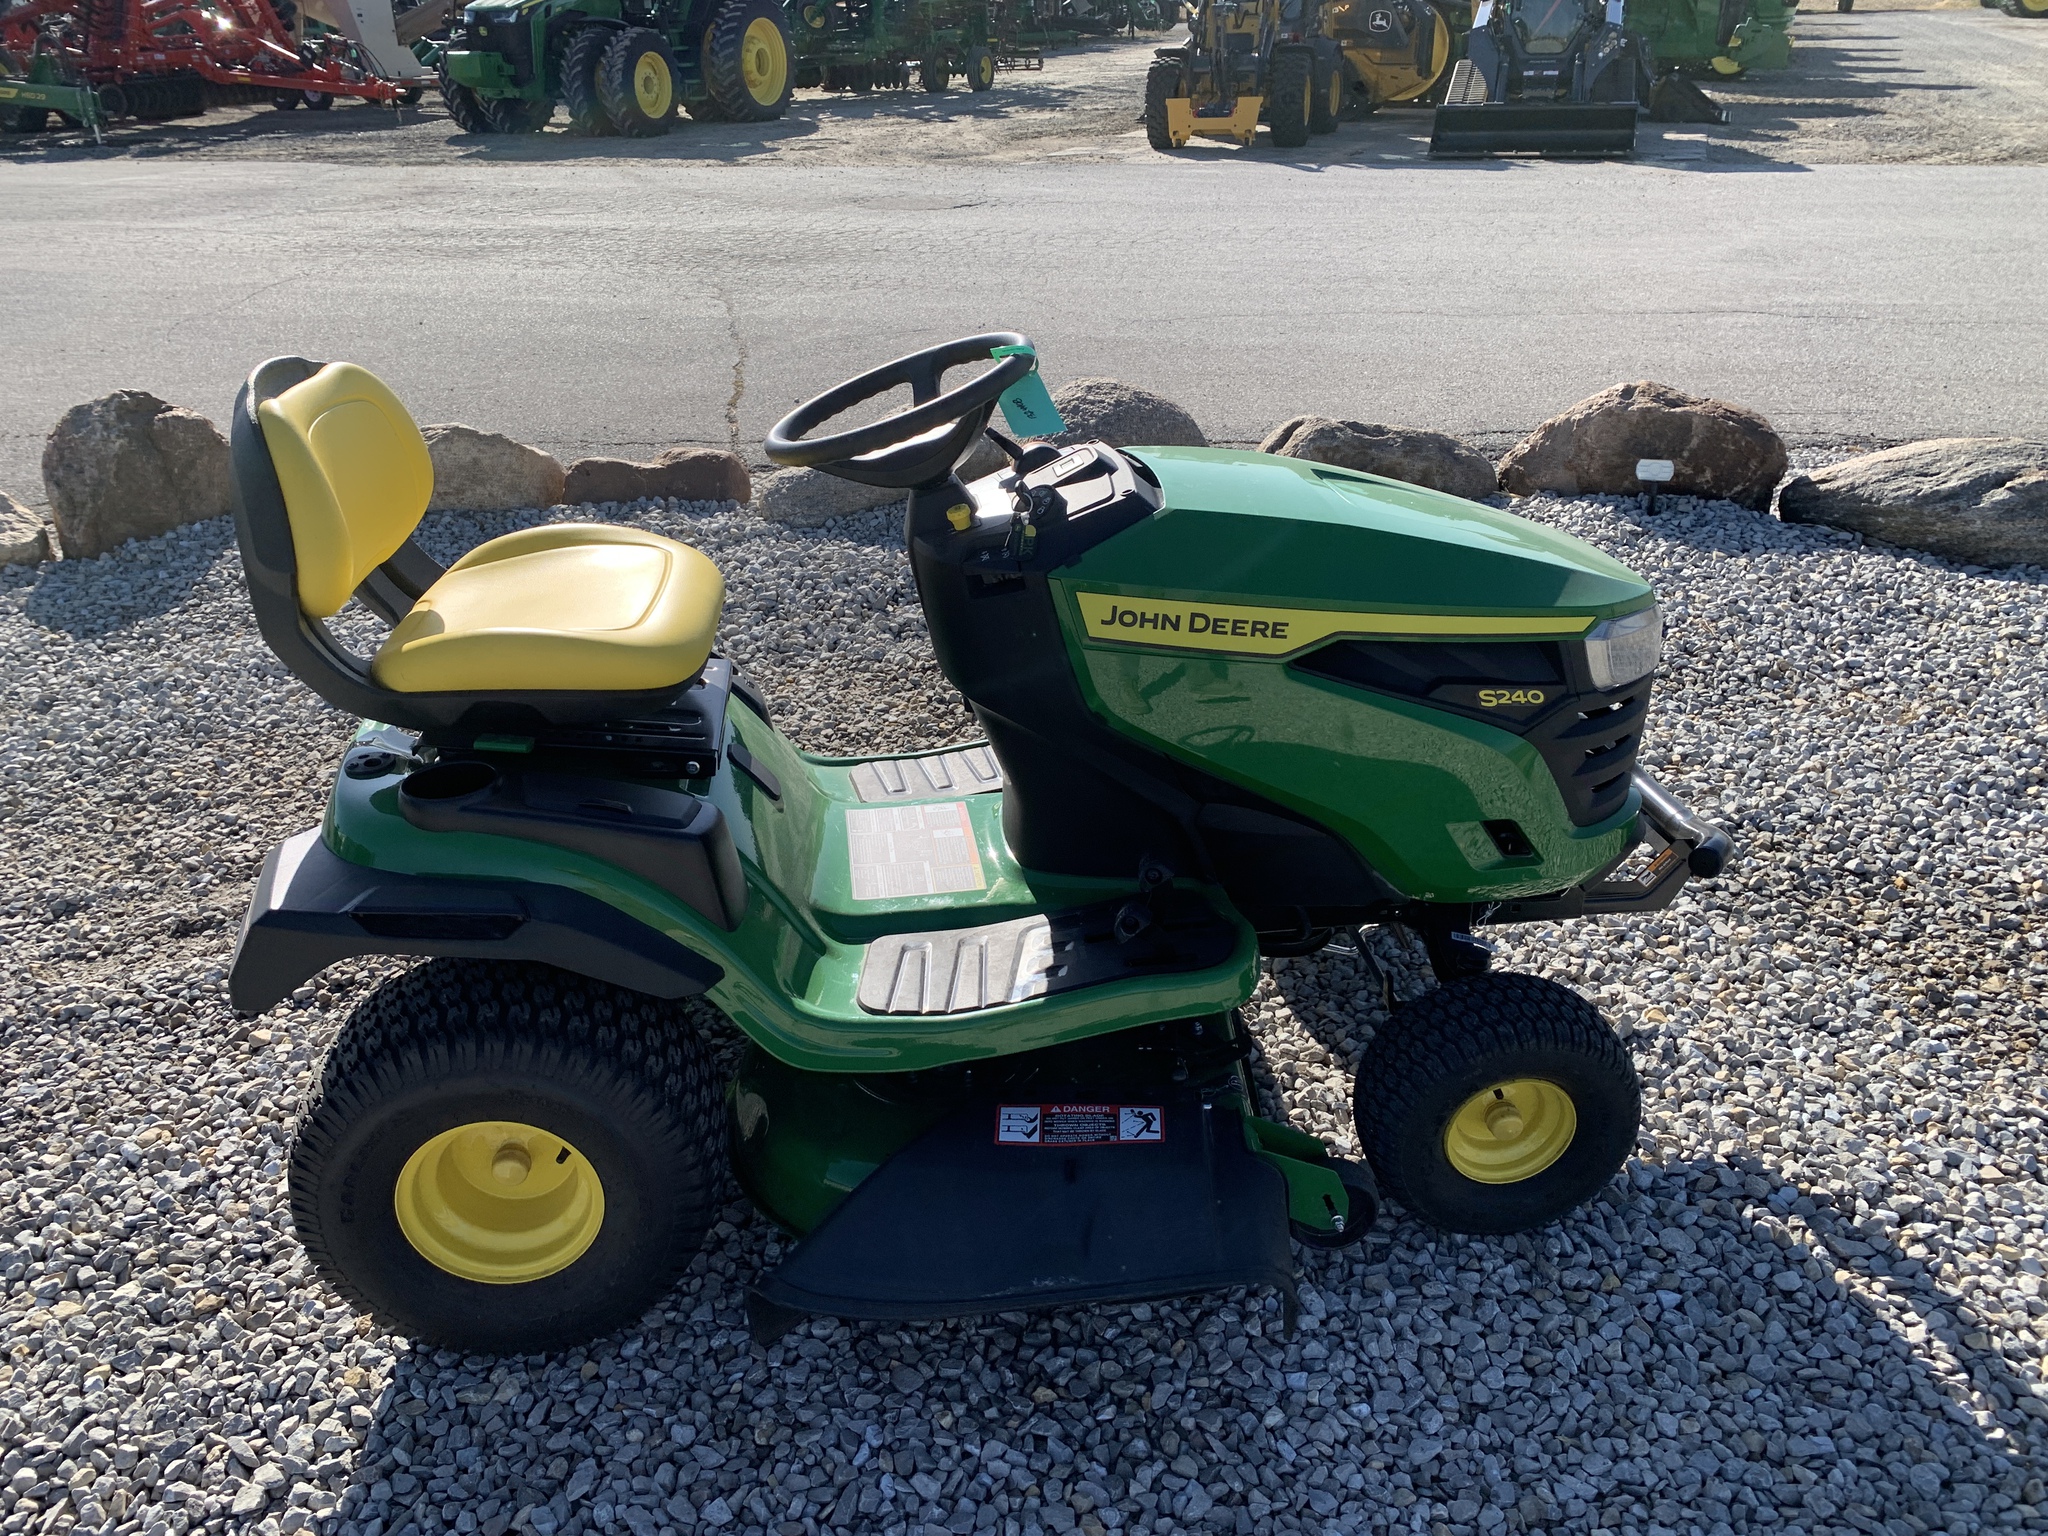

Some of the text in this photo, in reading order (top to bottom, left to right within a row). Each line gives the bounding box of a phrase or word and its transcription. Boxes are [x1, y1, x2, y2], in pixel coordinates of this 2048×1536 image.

[1101, 605, 1290, 639] JOHN DEERE
[1478, 689, 1545, 707] S240
[1063, 1105, 1110, 1113] DANGER
